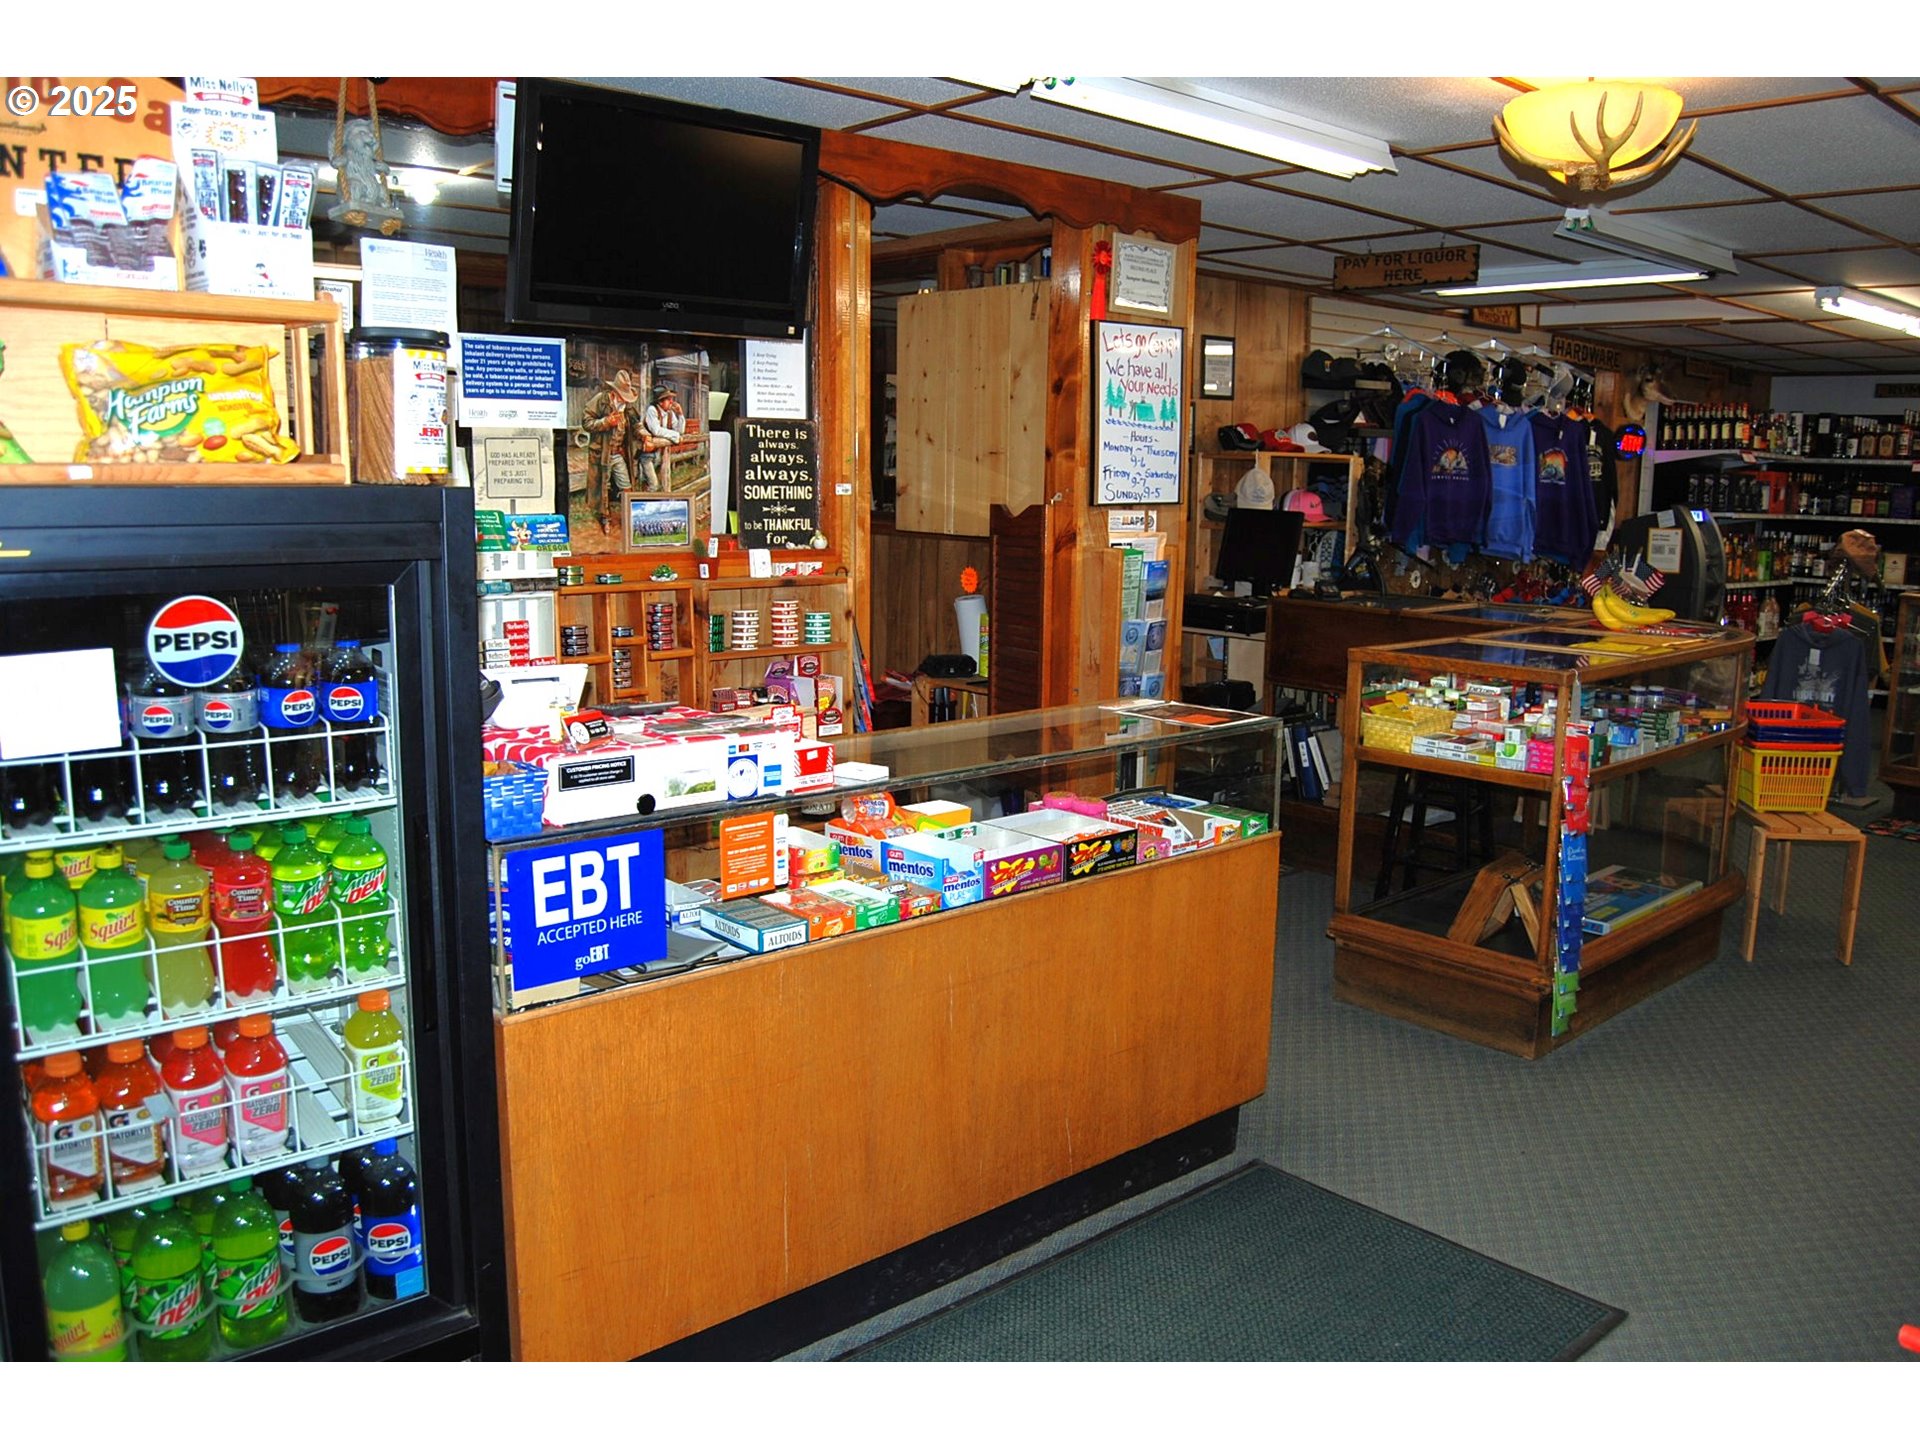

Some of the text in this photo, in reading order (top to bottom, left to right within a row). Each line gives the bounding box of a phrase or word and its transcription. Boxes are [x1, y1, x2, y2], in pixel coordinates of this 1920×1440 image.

[1342, 248, 1468, 271] PAY FOR LIQUOR
[1384, 268, 1423, 282] HERE
[662, 301, 680, 310] VIZIO
[465, 342, 474, 350] The
[1553, 338, 1622, 368] HARDWARE
[486, 351, 505, 359] delivery
[532, 354, 552, 362] persons
[476, 365, 486, 373] Any
[522, 360, 547, 368] prohibited
[1105, 358, 1168, 381] We have all
[510, 374, 528, 382] product
[103, 376, 204, 421] Hampton
[466, 387, 480, 395] years
[533, 389, 550, 397] Oregon
[127, 391, 200, 442] Farms
[746, 424, 808, 440] There is
[758, 439, 800, 451] always.
[1620, 434, 1645, 452] ATM
[488, 459, 515, 467] PREPARED
[515, 459, 526, 467] THE
[490, 452, 537, 461] GOD HAS ALREADY
[750, 451, 809, 467] always.
[501, 470, 514, 478] HE'S
[745, 465, 814, 485] always.
[493, 477, 522, 486] PREPARING
[744, 485, 813, 500] SOMETHING
[744, 518, 814, 531] to be THANKFUL
[766, 532, 788, 544] for
[537, 544, 569, 552] OREGON
[153, 629, 238, 653] PEPSI
[284, 701, 315, 713] PEPSI
[330, 697, 362, 707] PEPSI
[143, 715, 174, 725] PEPSI
[204, 711, 233, 720] PEPSI
[566, 760, 627, 774] CUSTOMER PRICING NOTICE
[1137, 823, 1164, 838] CHEW
[888, 860, 935, 878] mentos
[531, 841, 641, 928] EBT
[943, 877, 982, 893] mentos
[230, 887, 265, 898] Country
[238, 893, 260, 903] Time
[167, 895, 202, 907] Country
[174, 902, 197, 912] Time
[89, 909, 138, 943] Squirt
[537, 911, 643, 946] ACCEPTED HERE
[714, 919, 741, 940] ALTOIDS
[768, 929, 803, 947] ALTOIDS
[574, 944, 610, 971] goEBT
[371, 1071, 397, 1087] ZERO
[252, 1102, 281, 1119] ZERO
[192, 1117, 222, 1133] ZERO
[370, 1235, 409, 1249] PEPSI
[311, 1247, 351, 1266] PEPSI
